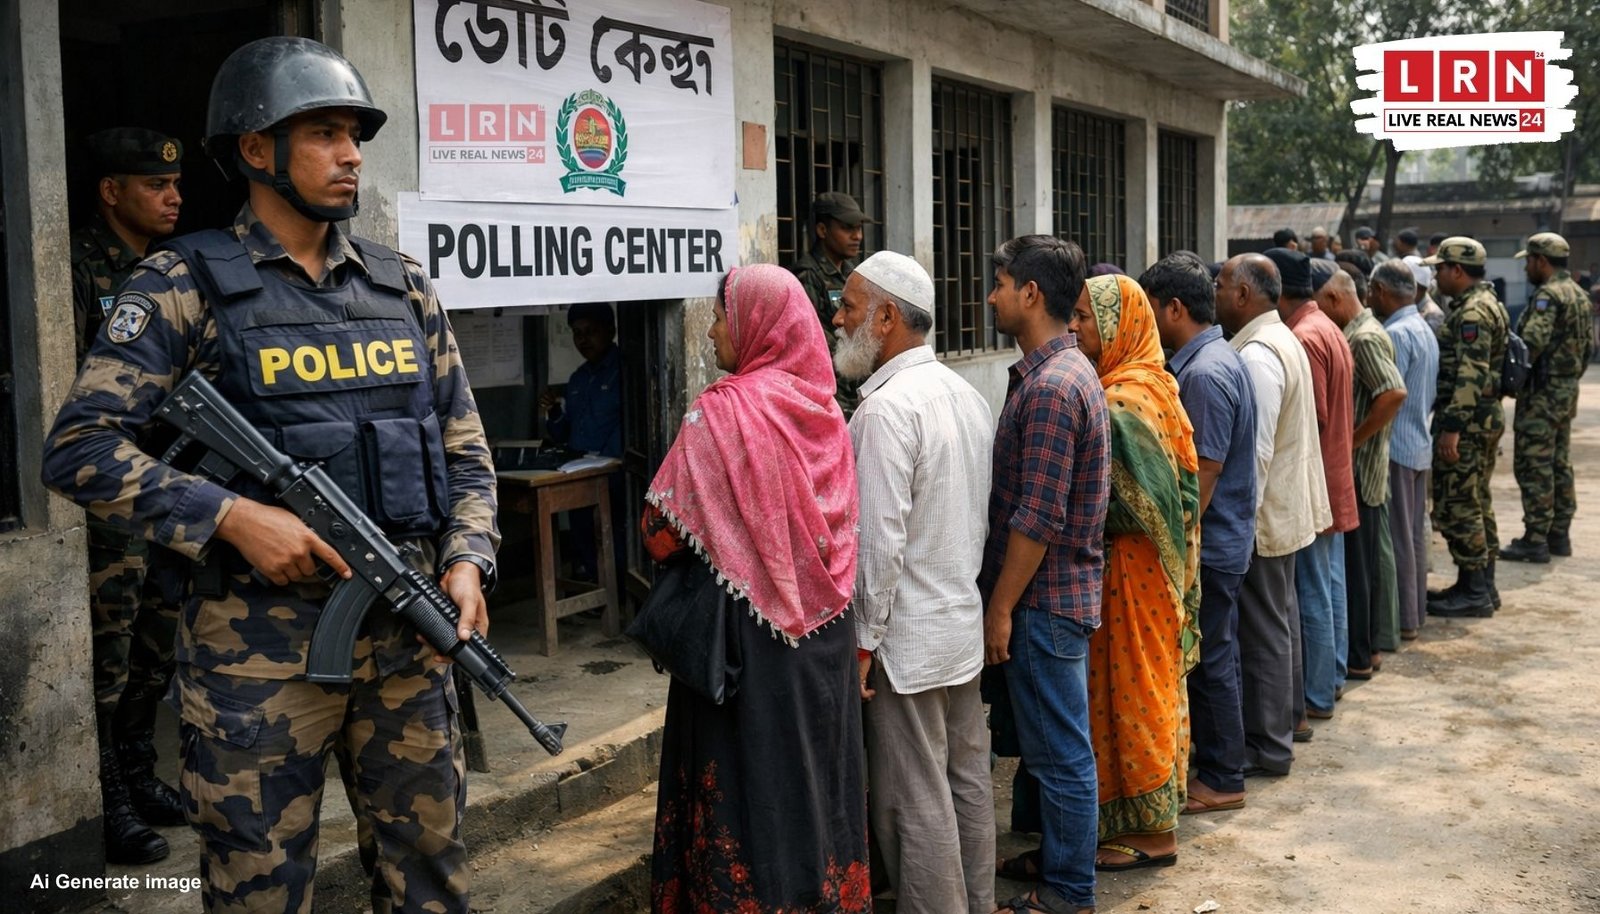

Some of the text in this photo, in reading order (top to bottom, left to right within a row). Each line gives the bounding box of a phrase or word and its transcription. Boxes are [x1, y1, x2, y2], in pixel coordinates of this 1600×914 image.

[428, 223, 724, 279] POLLING CENTER
[258, 339, 419, 385] POLICE
